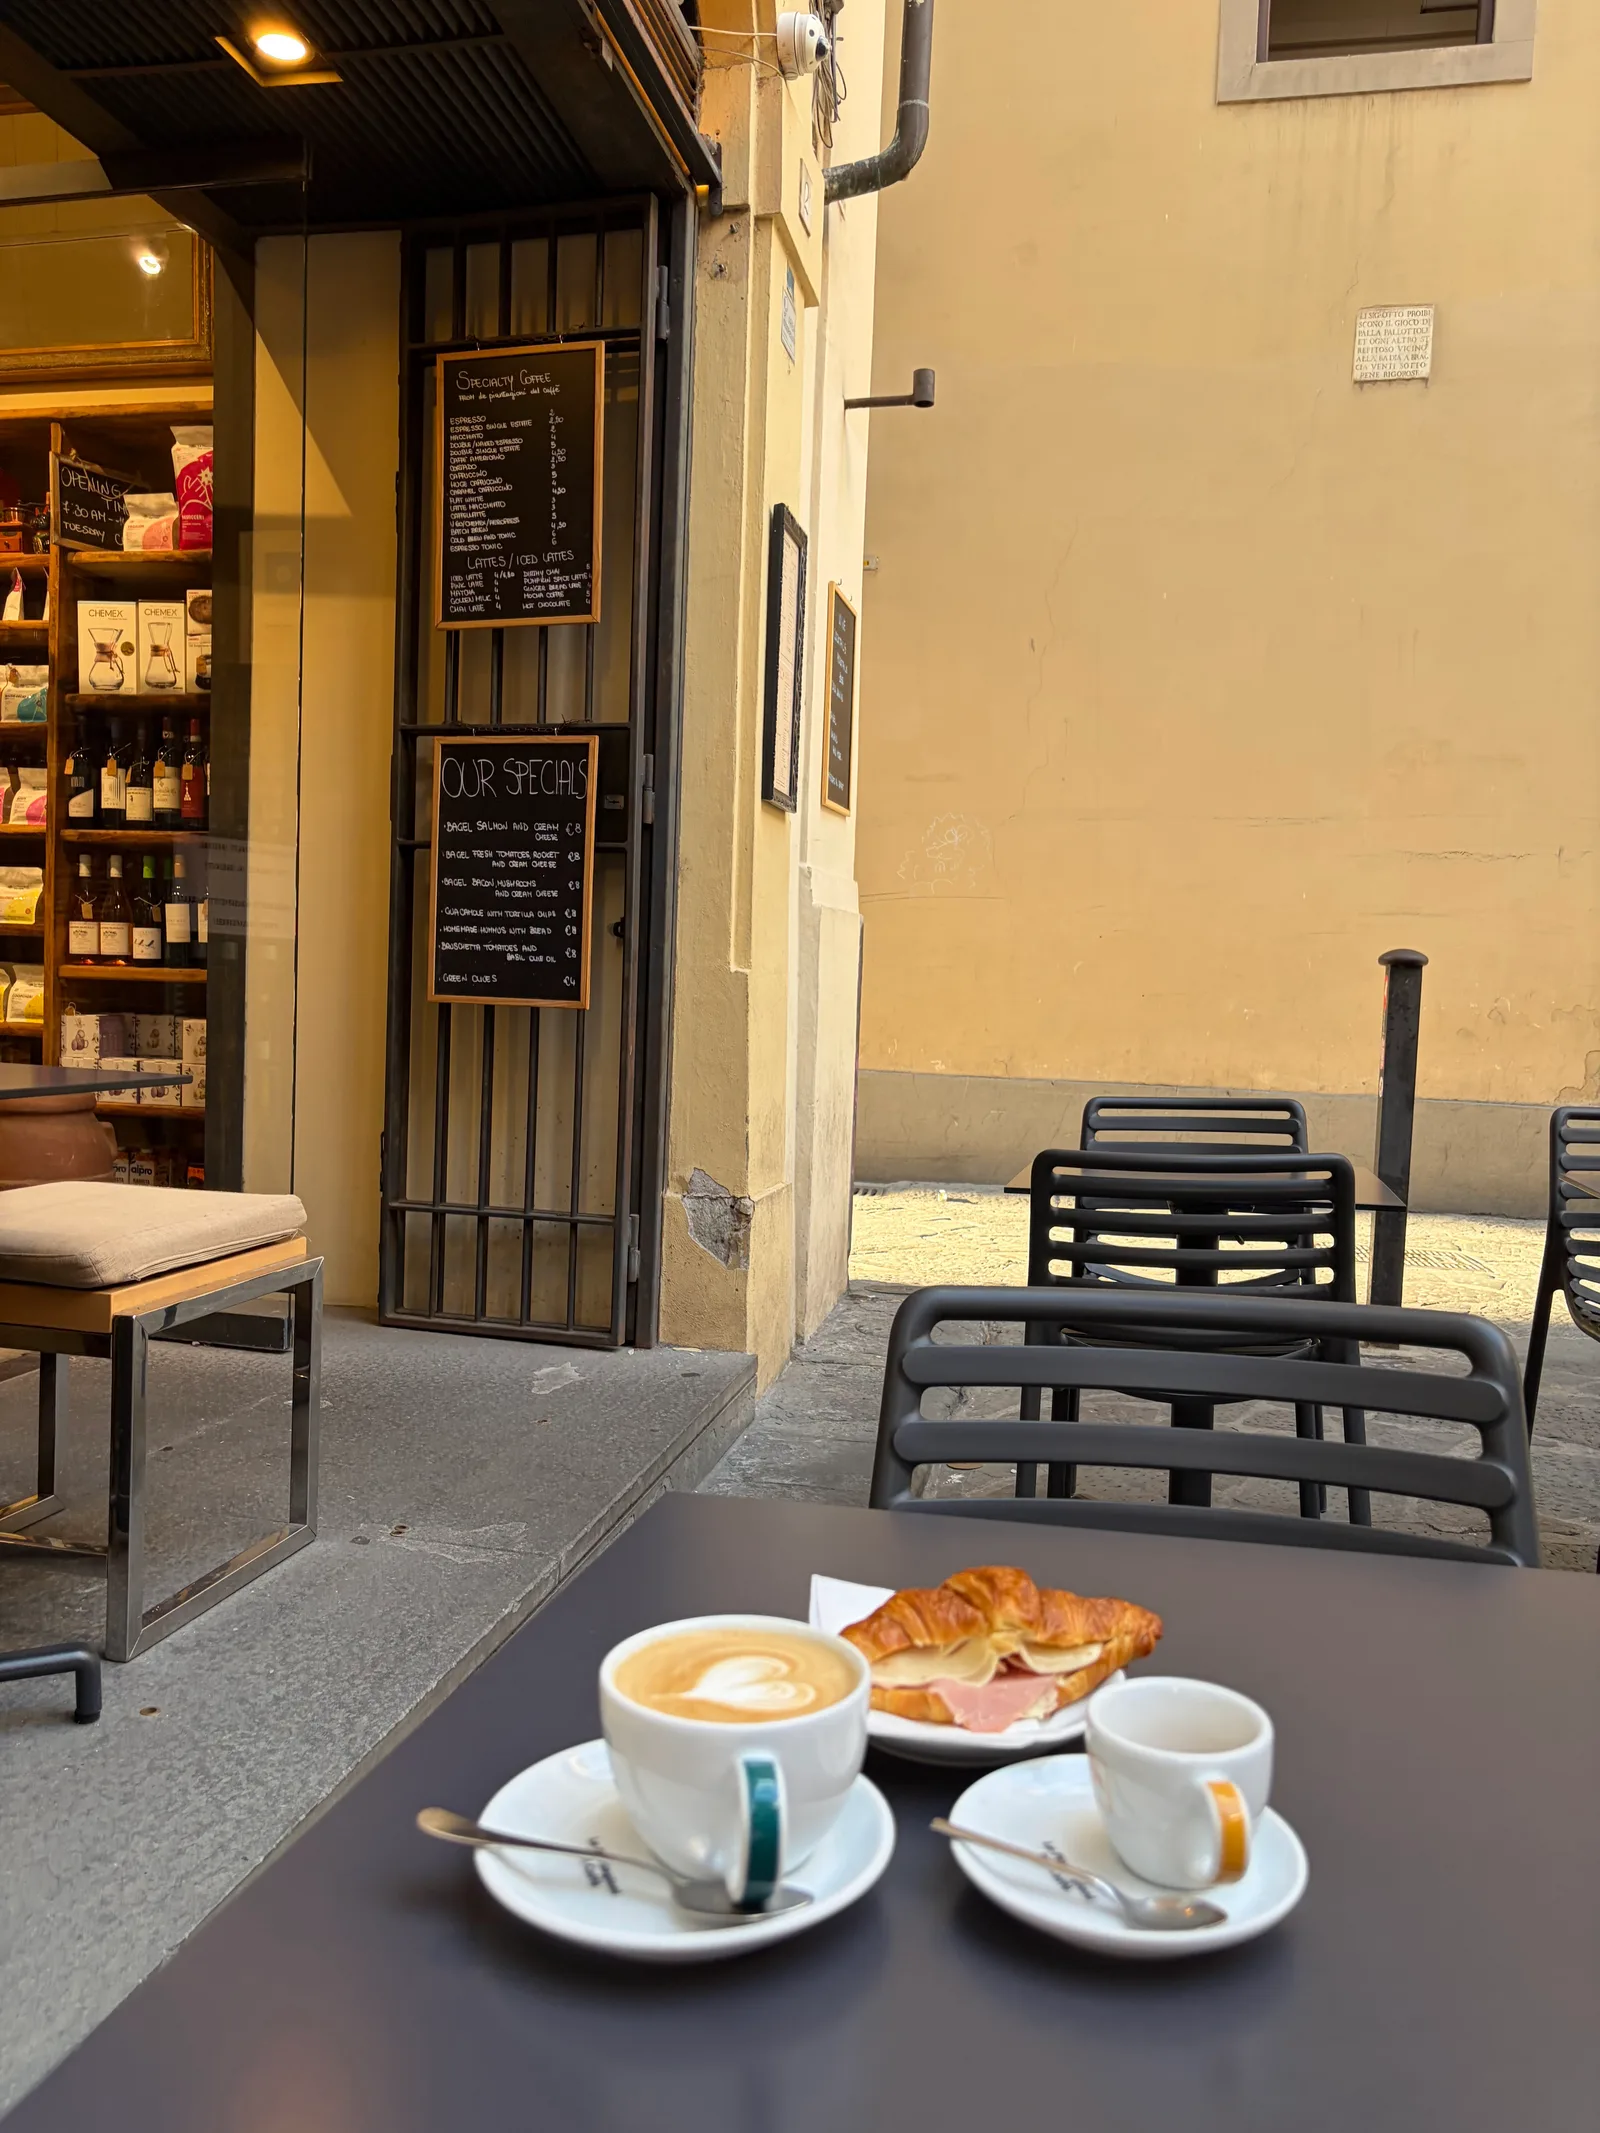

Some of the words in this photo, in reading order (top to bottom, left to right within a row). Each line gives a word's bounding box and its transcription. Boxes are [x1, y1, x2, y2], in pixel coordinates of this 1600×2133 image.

[1358, 320, 1384, 328] SCONO
[1394, 319, 1420, 327] GIOCO
[1358, 328, 1382, 336] PALLA
[1391, 336, 1417, 344] ALTRO
[520, 369, 552, 385] COFFEE
[450, 415, 487, 426] ESPRESSO
[450, 425, 484, 434] ESPRESSO
[450, 432, 484, 441] MACCHIATO
[496, 438, 524, 446] ESPRESSO
[450, 448, 473, 456] DOUBLE
[470, 454, 506, 462] AMERICANO
[450, 464, 477, 472] CORTADO
[449, 470, 488, 480] CAPPUCCINO
[61, 466, 121, 497] OPENING
[450, 480, 468, 488] HUGE
[470, 476, 503, 486] CAPPUCCINO
[450, 488, 476, 496] CARAMEL
[478, 483, 513, 493] CAPPUCCINO
[450, 496, 463, 504] FLAT
[450, 504, 467, 512] LATTE
[469, 501, 506, 510] MACCHIATO
[90, 510, 106, 522] AM
[63, 520, 106, 543] TUESDAY
[497, 532, 516, 540] TONIC
[450, 544, 480, 553] ESPRESSO
[482, 542, 503, 550] TONIC
[542, 550, 574, 563] LATTES
[466, 572, 484, 580] LATTE
[570, 572, 588, 580] LATTE
[450, 605, 466, 613] CHAI
[522, 602, 534, 610] HOT
[538, 600, 570, 608] CHOCOLATE
[88, 608, 124, 618] CHEMEX
[144, 608, 178, 616] CHEMEX
[442, 757, 498, 798] OUR
[503, 757, 588, 800] SPECIALS
[446, 820, 473, 832] BAGEL
[476, 820, 508, 832] SALMON
[512, 822, 528, 832] AND
[534, 822, 560, 832] CREAM
[566, 822, 582, 836] €8
[534, 832, 558, 842] CHEESE
[446, 850, 470, 860] BAGEL
[472, 850, 493, 858] FRESH
[568, 852, 581, 862] €8
[444, 878, 467, 886] BAGEL
[568, 880, 580, 890] €8
[494, 890, 510, 898] AND
[511, 890, 532, 898] CREAM
[536, 890, 558, 898] CHEESE
[444, 907, 484, 917] GUACAMOLE
[487, 909, 503, 917] WITH
[504, 910, 534, 918] TORTILLA
[538, 910, 556, 918] CHIPS
[564, 908, 577, 918] €8
[509, 927, 526, 935] WITH
[530, 926, 552, 934] BREAD
[564, 924, 577, 936] €8
[441, 941, 481, 951] BRUSCHETTA
[483, 942, 518, 952] TOMATOES
[522, 944, 538, 952] AND
[565, 948, 577, 958] €8
[506, 952, 526, 961] BASIL
[443, 972, 468, 982] GREEN
[472, 974, 498, 983] OLIVES
[563, 976, 576, 987] €4
[131, 1164, 152, 1176] alpro
